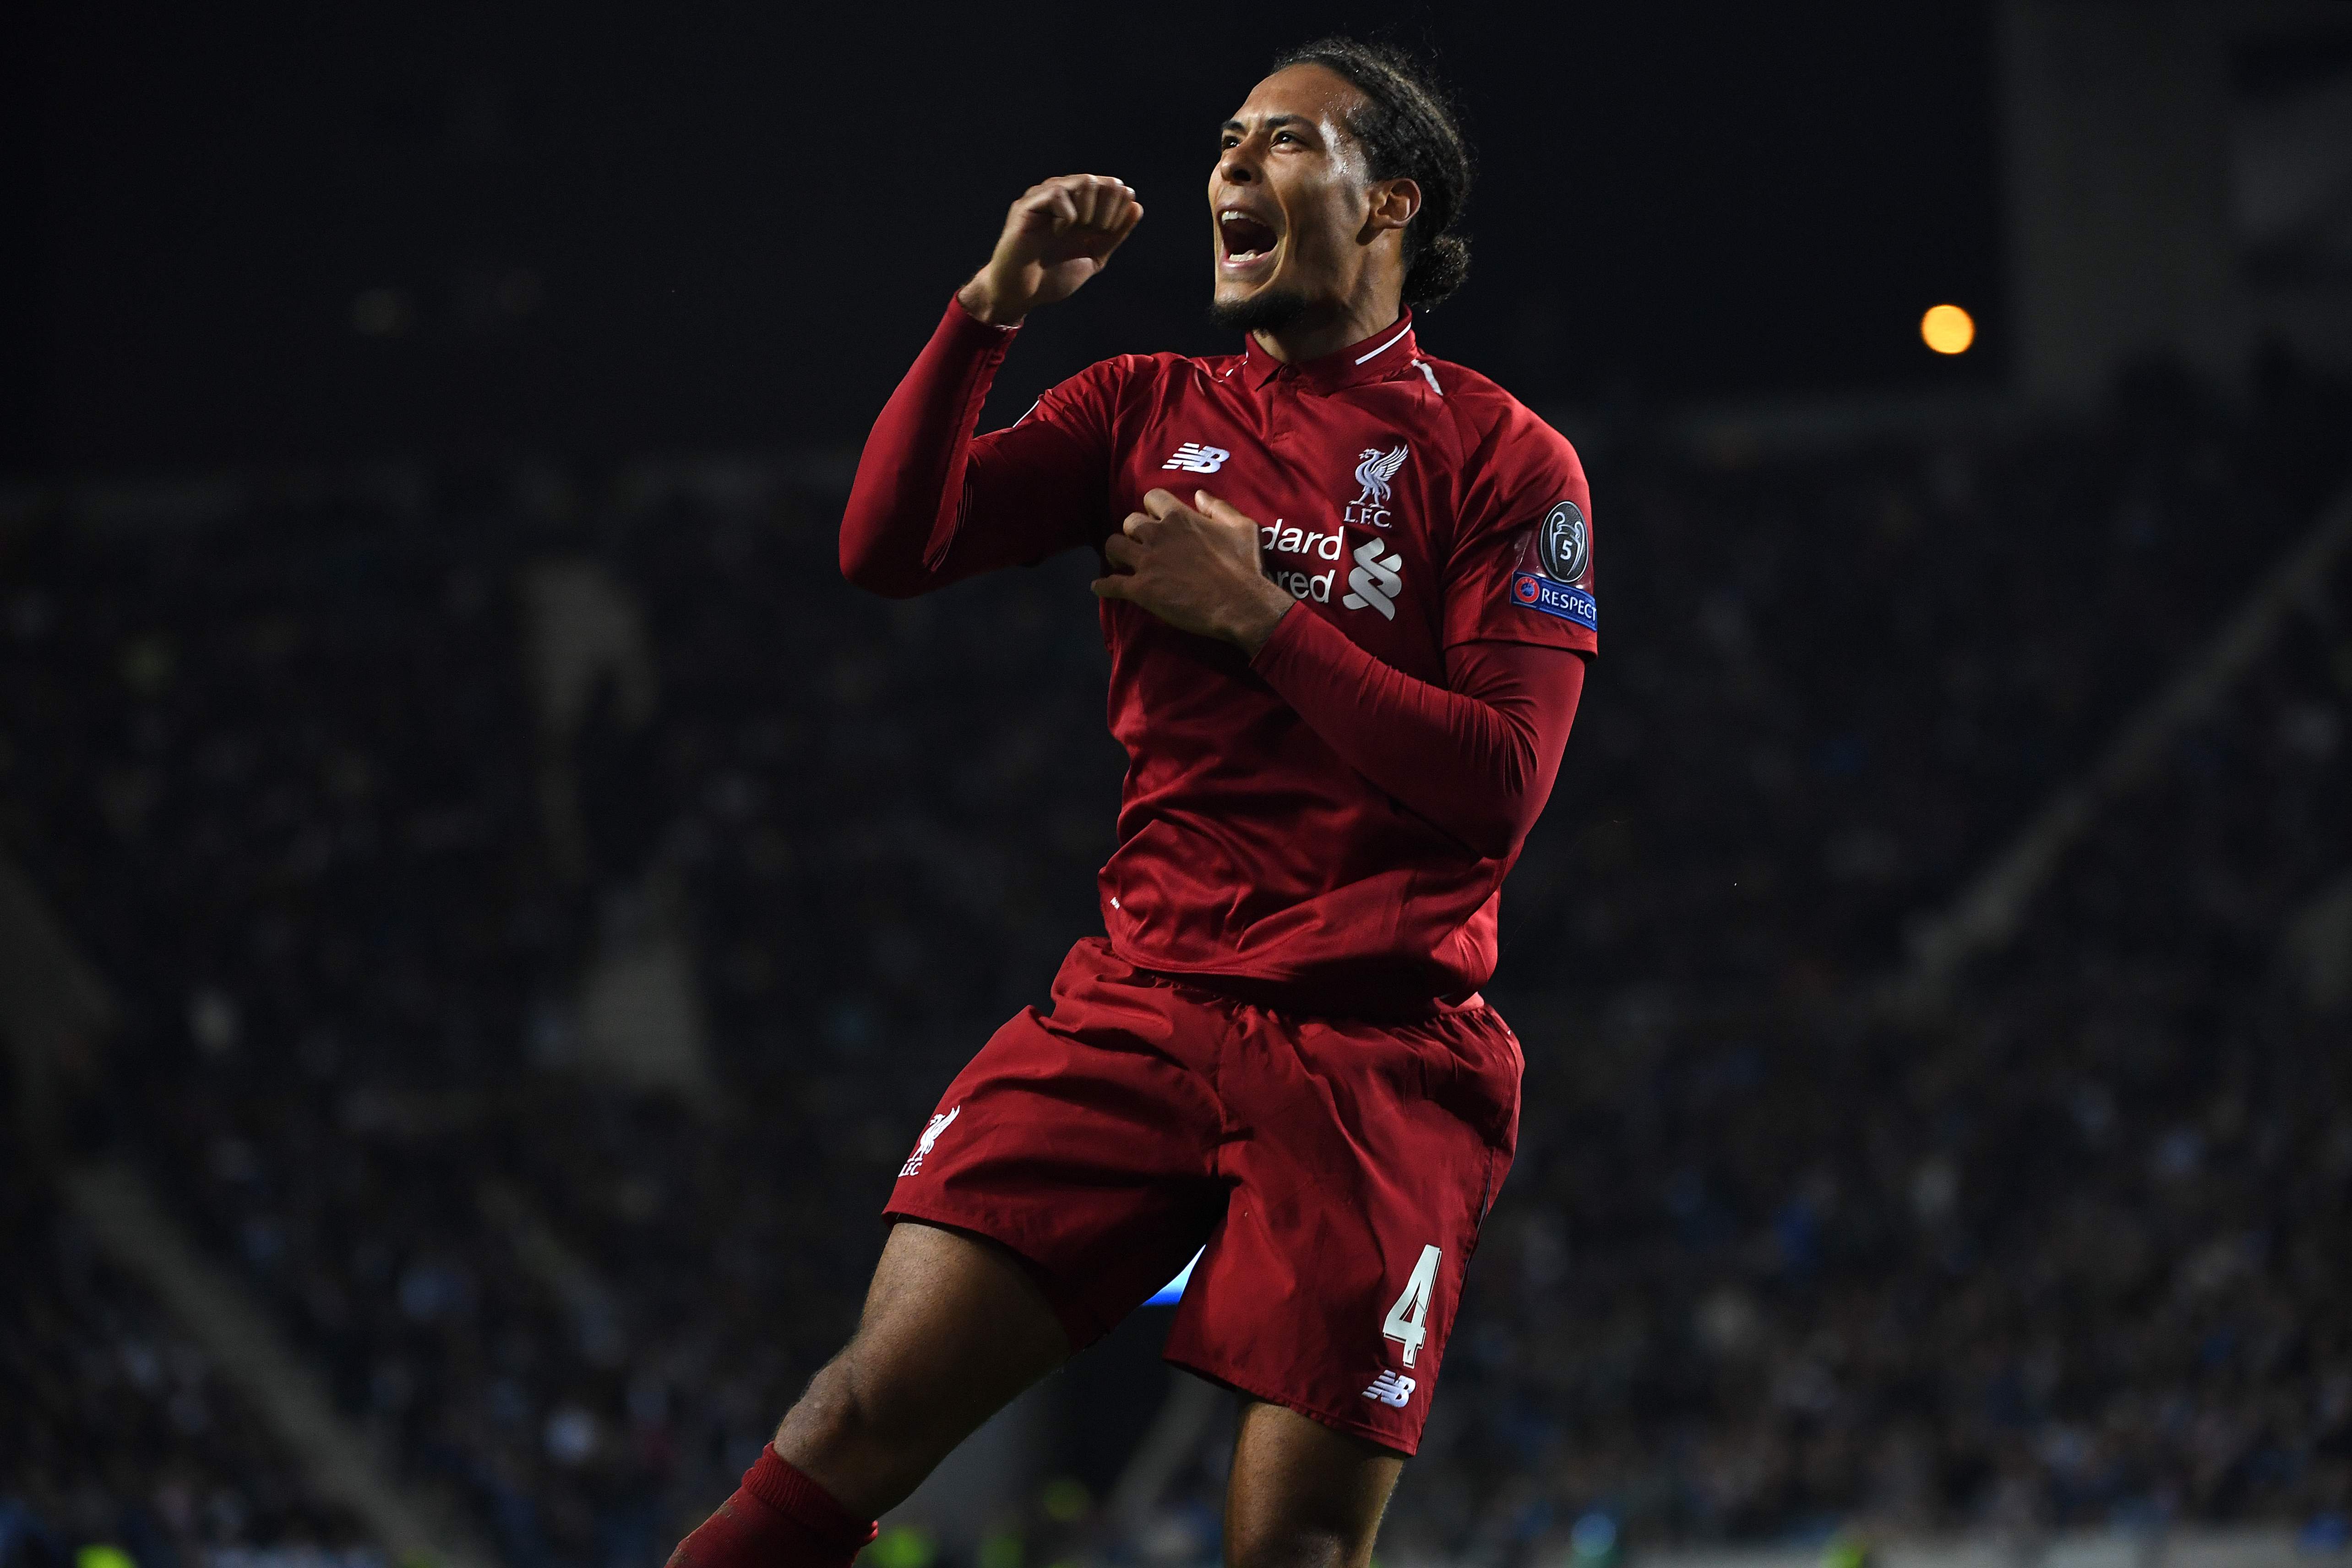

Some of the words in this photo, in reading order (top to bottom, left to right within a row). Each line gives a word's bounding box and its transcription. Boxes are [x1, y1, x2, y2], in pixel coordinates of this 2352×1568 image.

[1560, 540, 1572, 560] 5
[1541, 588, 1596, 621] RESPECT
[1383, 1244, 1442, 1369] 4
